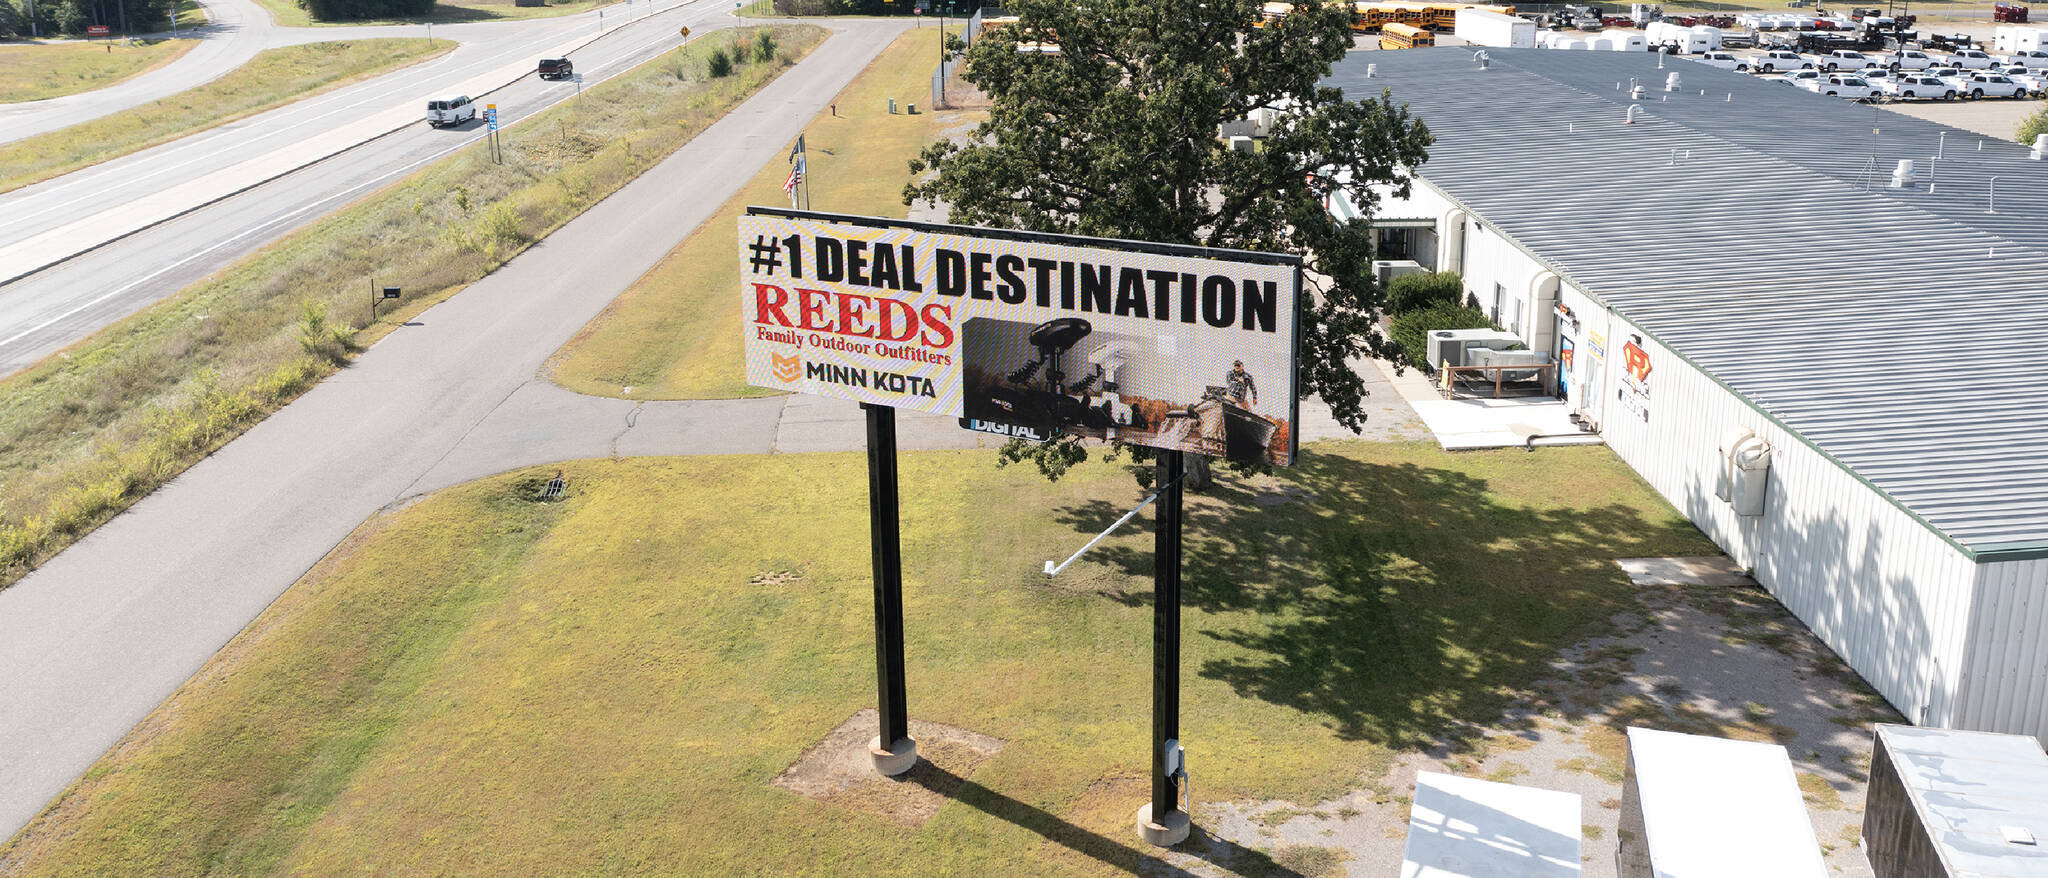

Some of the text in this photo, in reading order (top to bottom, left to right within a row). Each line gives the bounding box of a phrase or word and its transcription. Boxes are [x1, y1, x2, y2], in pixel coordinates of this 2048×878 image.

[749, 234, 1277, 333] #1 DEAL DESTINATION
[751, 283, 954, 349] REEDS
[756, 326, 952, 367] Family Outdoor Outfitters
[806, 361, 936, 398] MINN KOTA
